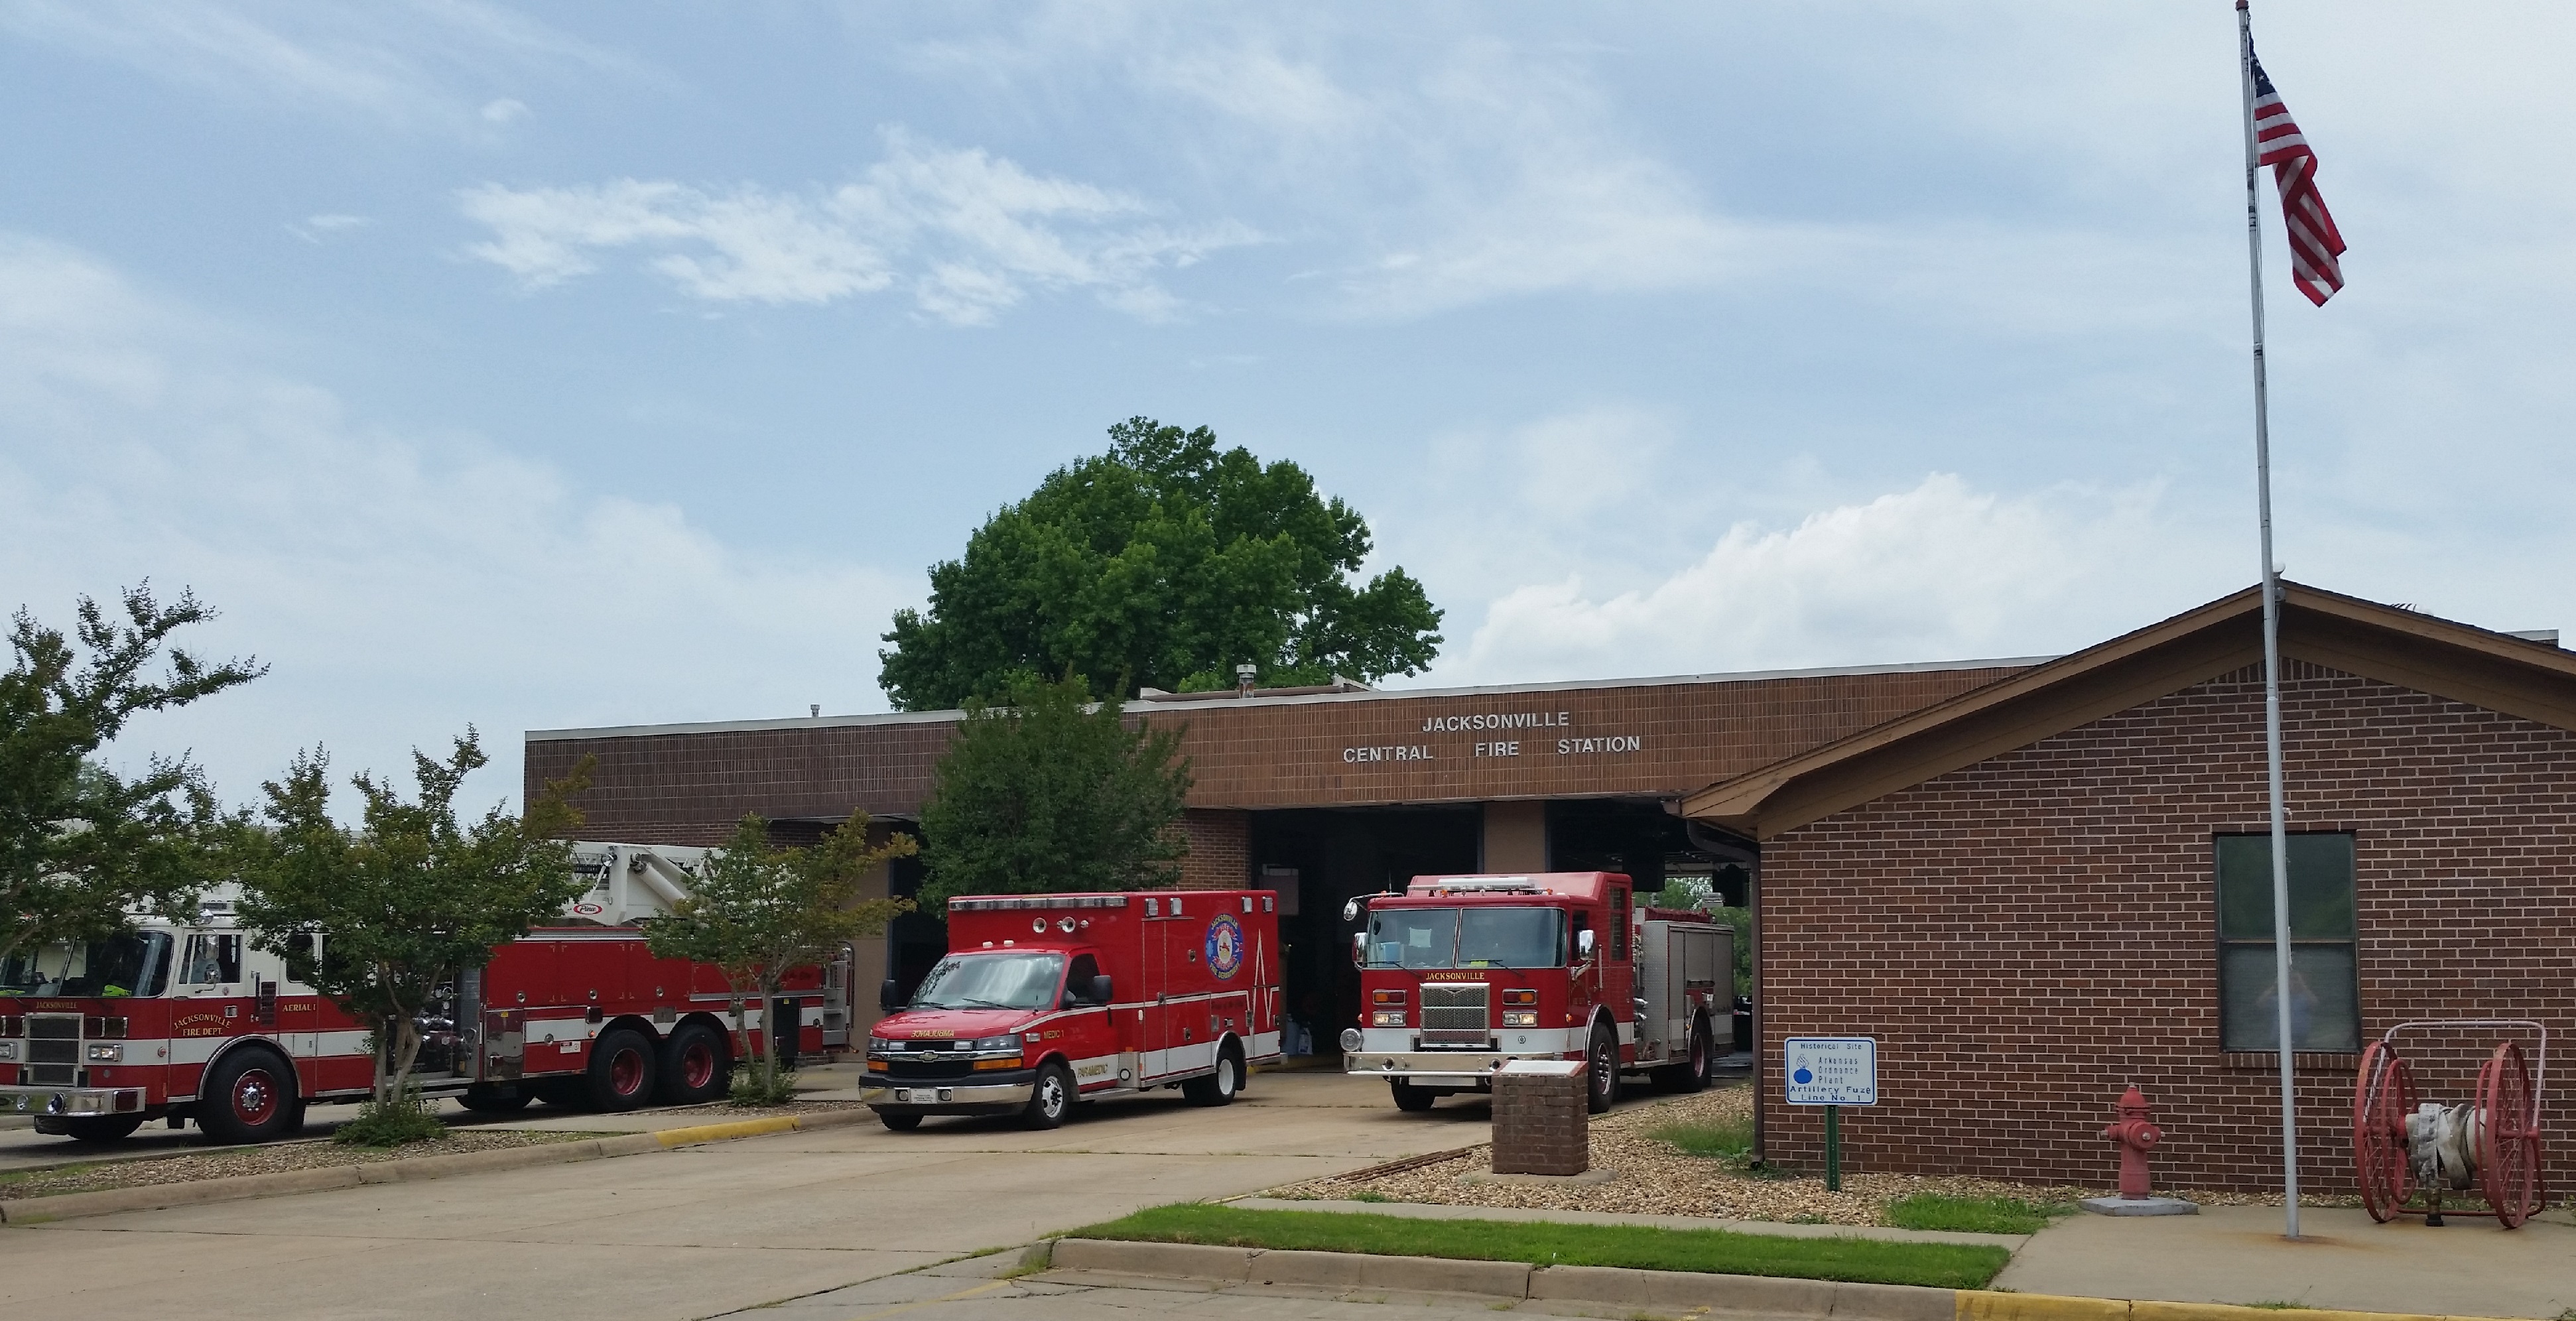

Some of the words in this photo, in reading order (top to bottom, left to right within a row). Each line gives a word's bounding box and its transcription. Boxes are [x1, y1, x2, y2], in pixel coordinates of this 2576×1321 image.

[1423, 712, 1570, 732] JACKSONVILLE
[1342, 745, 1434, 763] CENTRAL
[1474, 741, 1520, 757] FIRE
[1557, 736, 1642, 755] STATION
[1211, 914, 1238, 930] JACKSONVILLE
[282, 1003, 312, 1012] AERIAL
[174, 1013, 232, 1031] JACKSONVILLE
[1043, 1030, 1061, 1039] MEDIC
[1077, 1062, 1108, 1078] PARAMEDIC
[1818, 1066, 1858, 1074] Ordnance
[1819, 1076, 1843, 1084] Plant
[1789, 1086, 1839, 1094] Artillery
